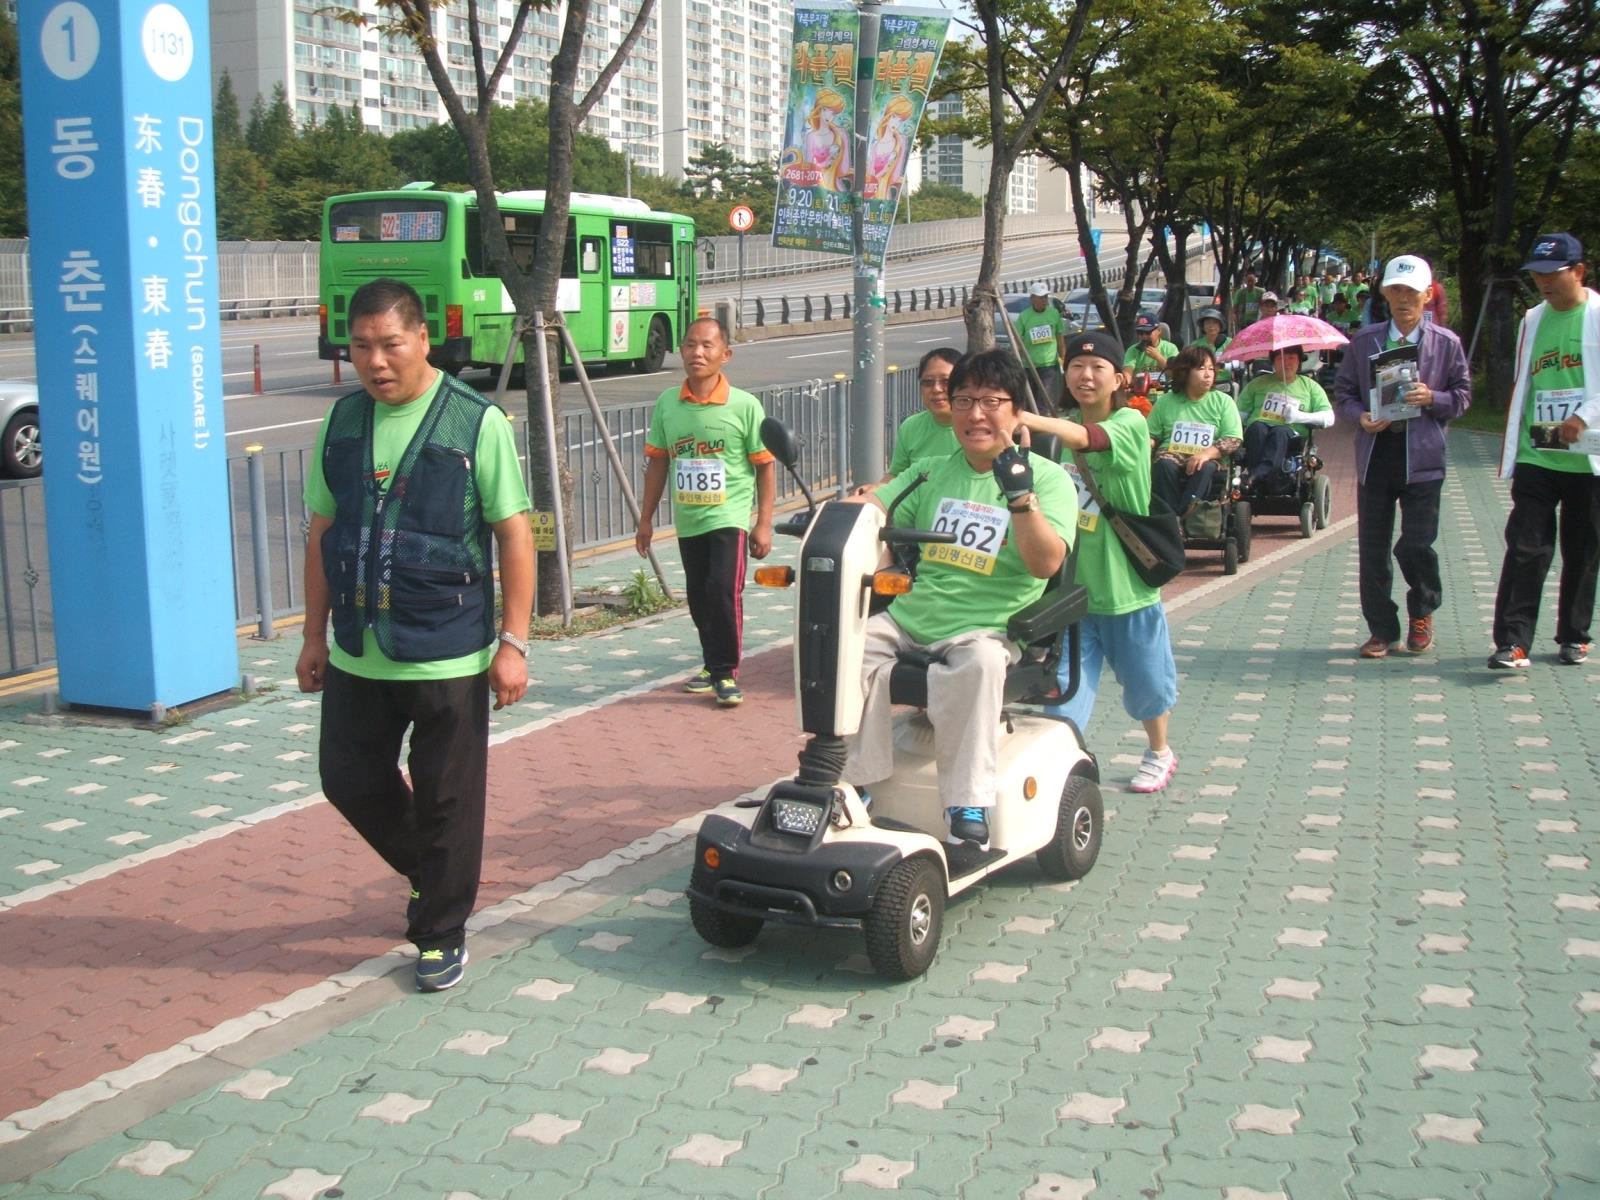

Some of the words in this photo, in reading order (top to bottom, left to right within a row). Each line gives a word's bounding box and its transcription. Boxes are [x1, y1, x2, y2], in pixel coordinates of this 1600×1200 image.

[61, 16, 76, 62] 1
[177, 116, 208, 331] Dongchun
[695, 439, 725, 457] Run
[1174, 430, 1210, 447] 0118
[677, 472, 721, 491] 0185
[934, 516, 997, 553] 0162
[939, 546, 987, 570] 인평신협
